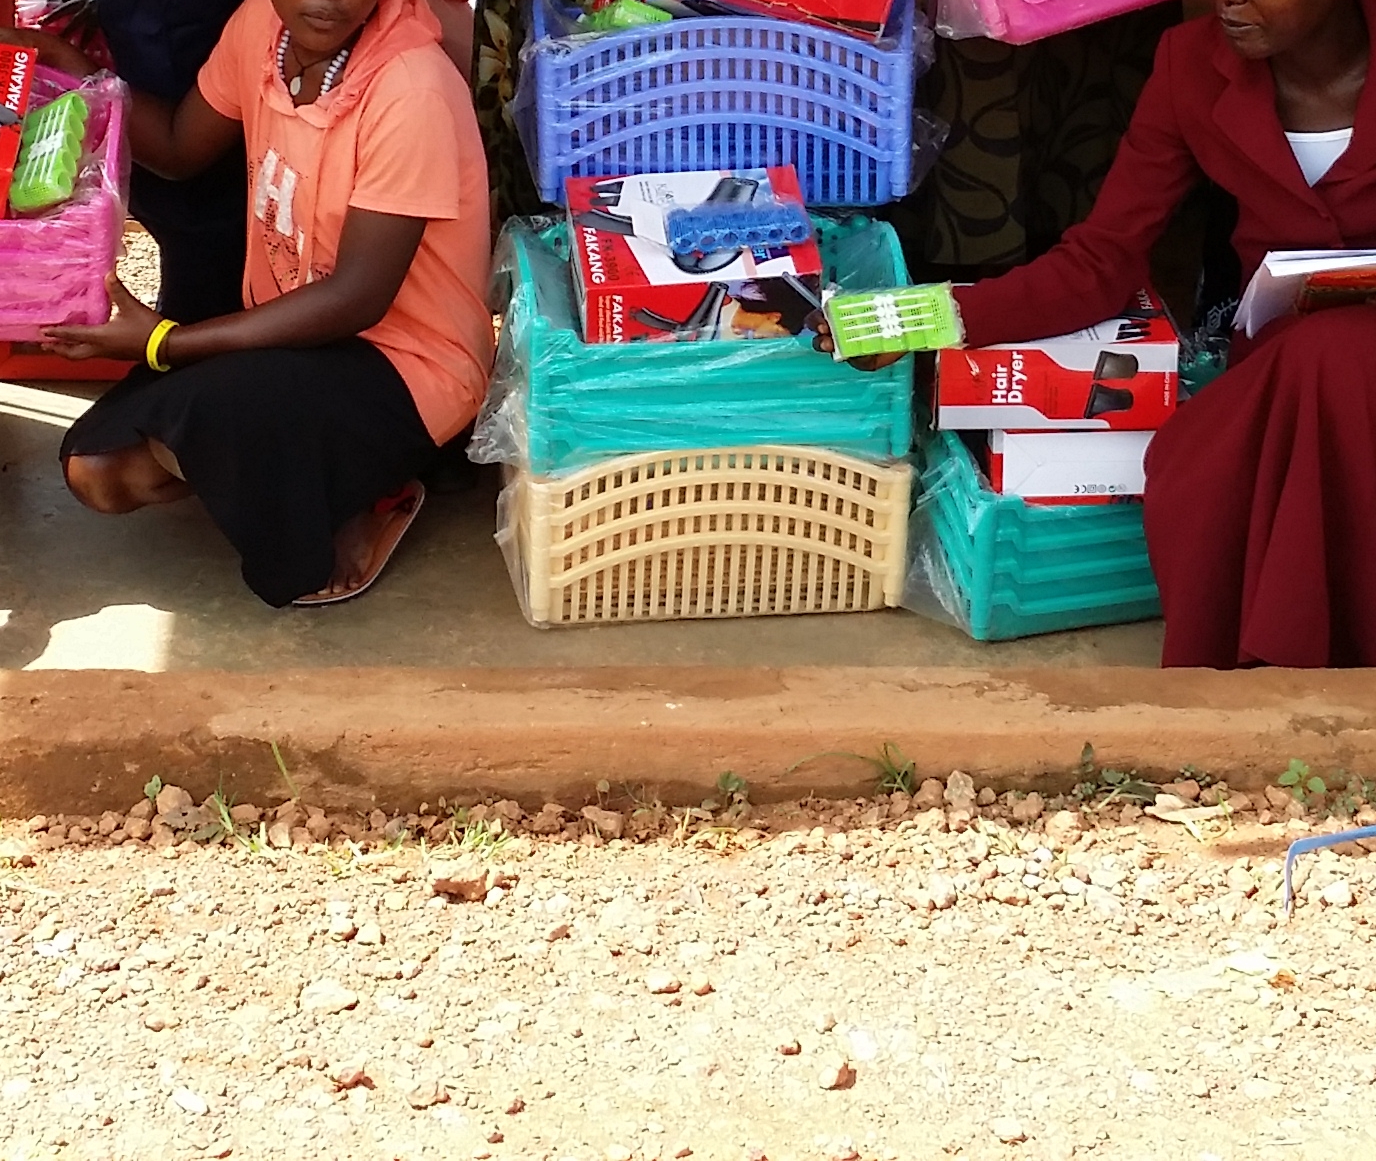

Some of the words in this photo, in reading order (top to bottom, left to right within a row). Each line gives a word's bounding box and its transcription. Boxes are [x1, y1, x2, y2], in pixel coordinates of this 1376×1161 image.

[5, 51, 28, 111] FAKANG
[583, 227, 605, 284] FAKANG
[991, 364, 1008, 404] Hair
[1008, 351, 1028, 404] Dryer
